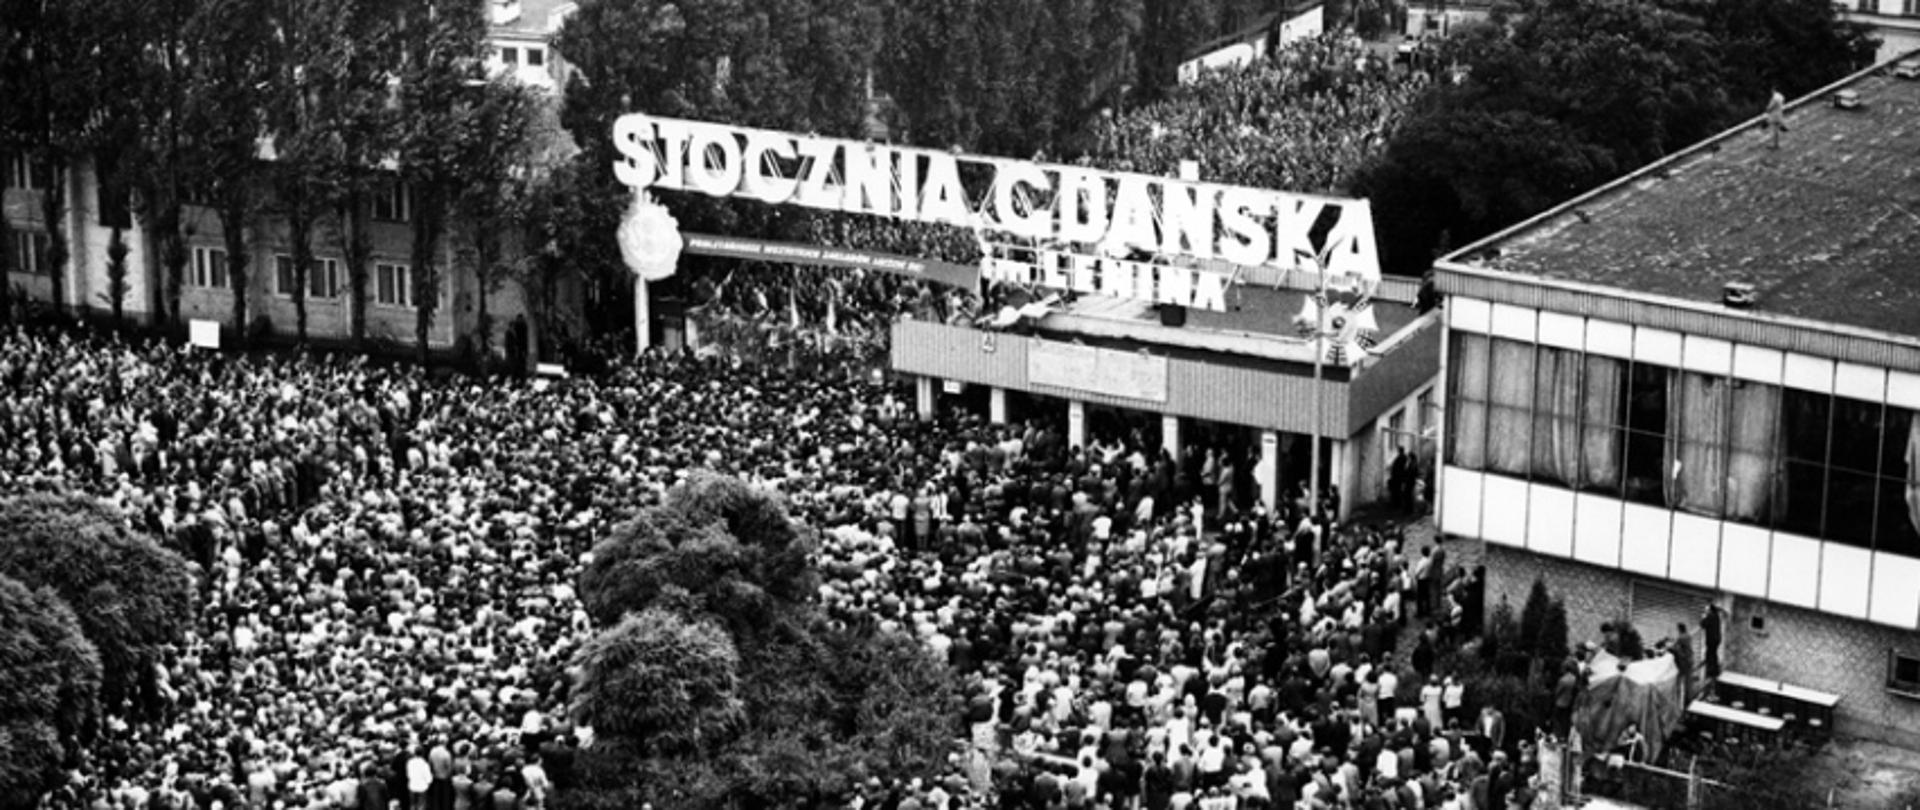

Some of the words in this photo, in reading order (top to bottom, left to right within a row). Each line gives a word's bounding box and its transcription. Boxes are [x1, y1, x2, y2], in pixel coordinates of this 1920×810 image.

[613, 113, 975, 226] STOCZNIA
[995, 160, 1380, 282] GDAŃSKA
[1043, 250, 1227, 313] LENINA
